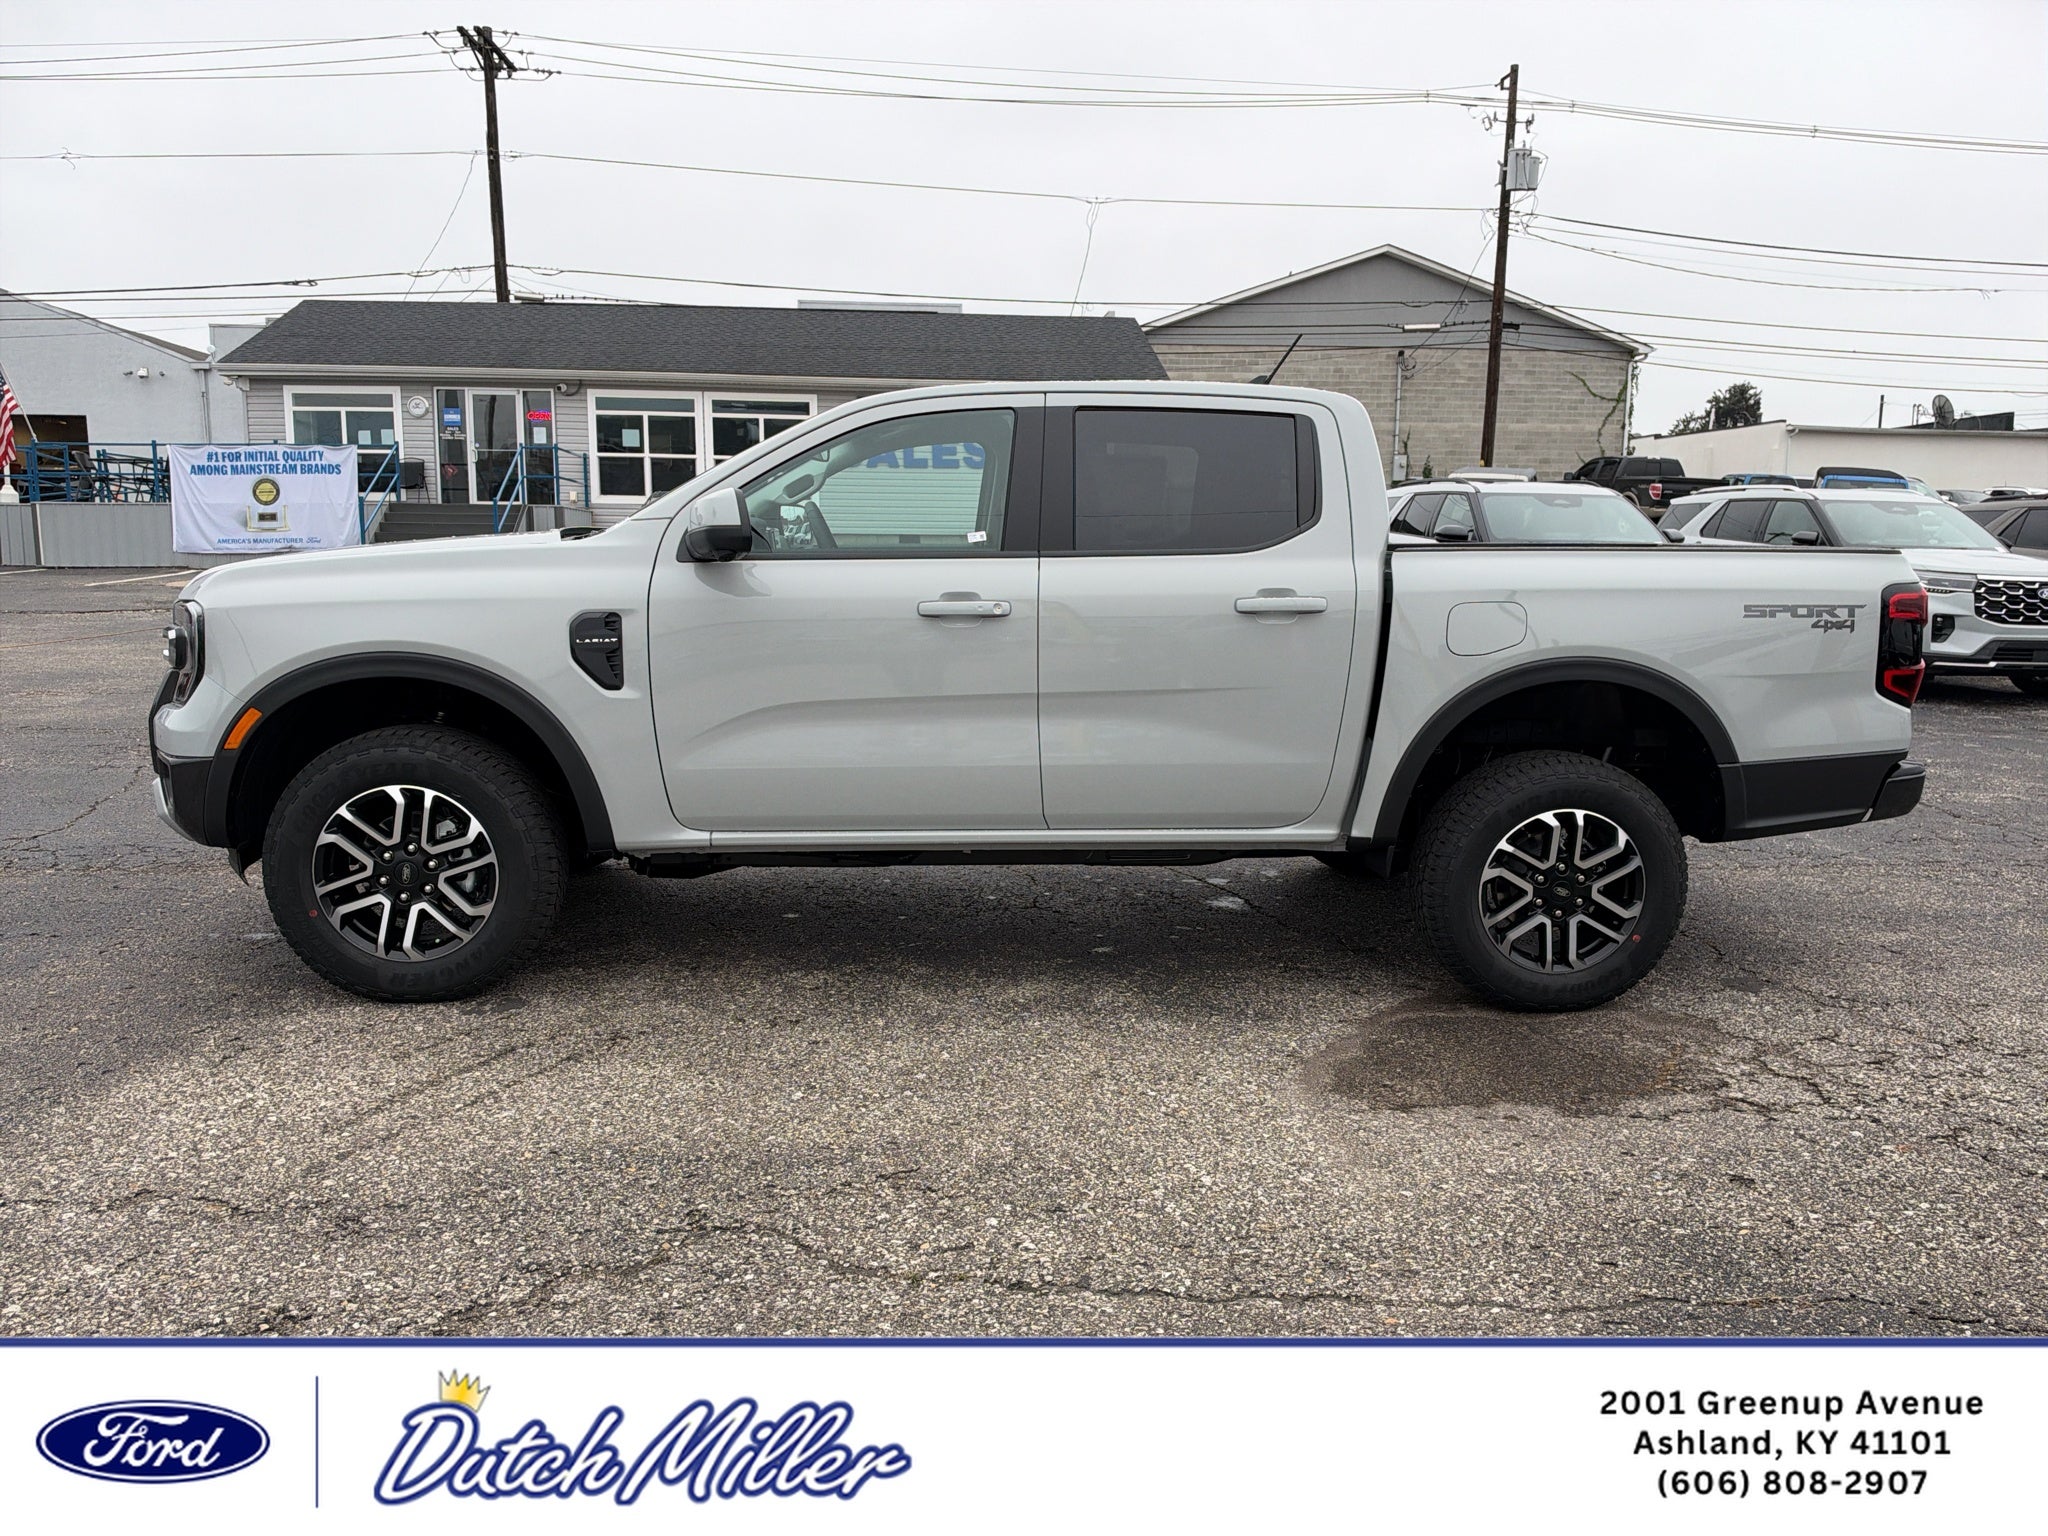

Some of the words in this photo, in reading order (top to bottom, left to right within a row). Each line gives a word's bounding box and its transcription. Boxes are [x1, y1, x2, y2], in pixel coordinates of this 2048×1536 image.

[206, 451, 220, 462] #1
[221, 451, 242, 463] FOR
[244, 450, 280, 462] INITIAL
[282, 450, 324, 463] QUALITY
[853, 442, 985, 469] ALES
[190, 464, 228, 476] AMONG
[230, 463, 298, 475] MAINSTREAM
[299, 463, 342, 475] BRANDS
[1742, 604, 1867, 619] SPORT
[1810, 619, 1856, 634] 4x4
